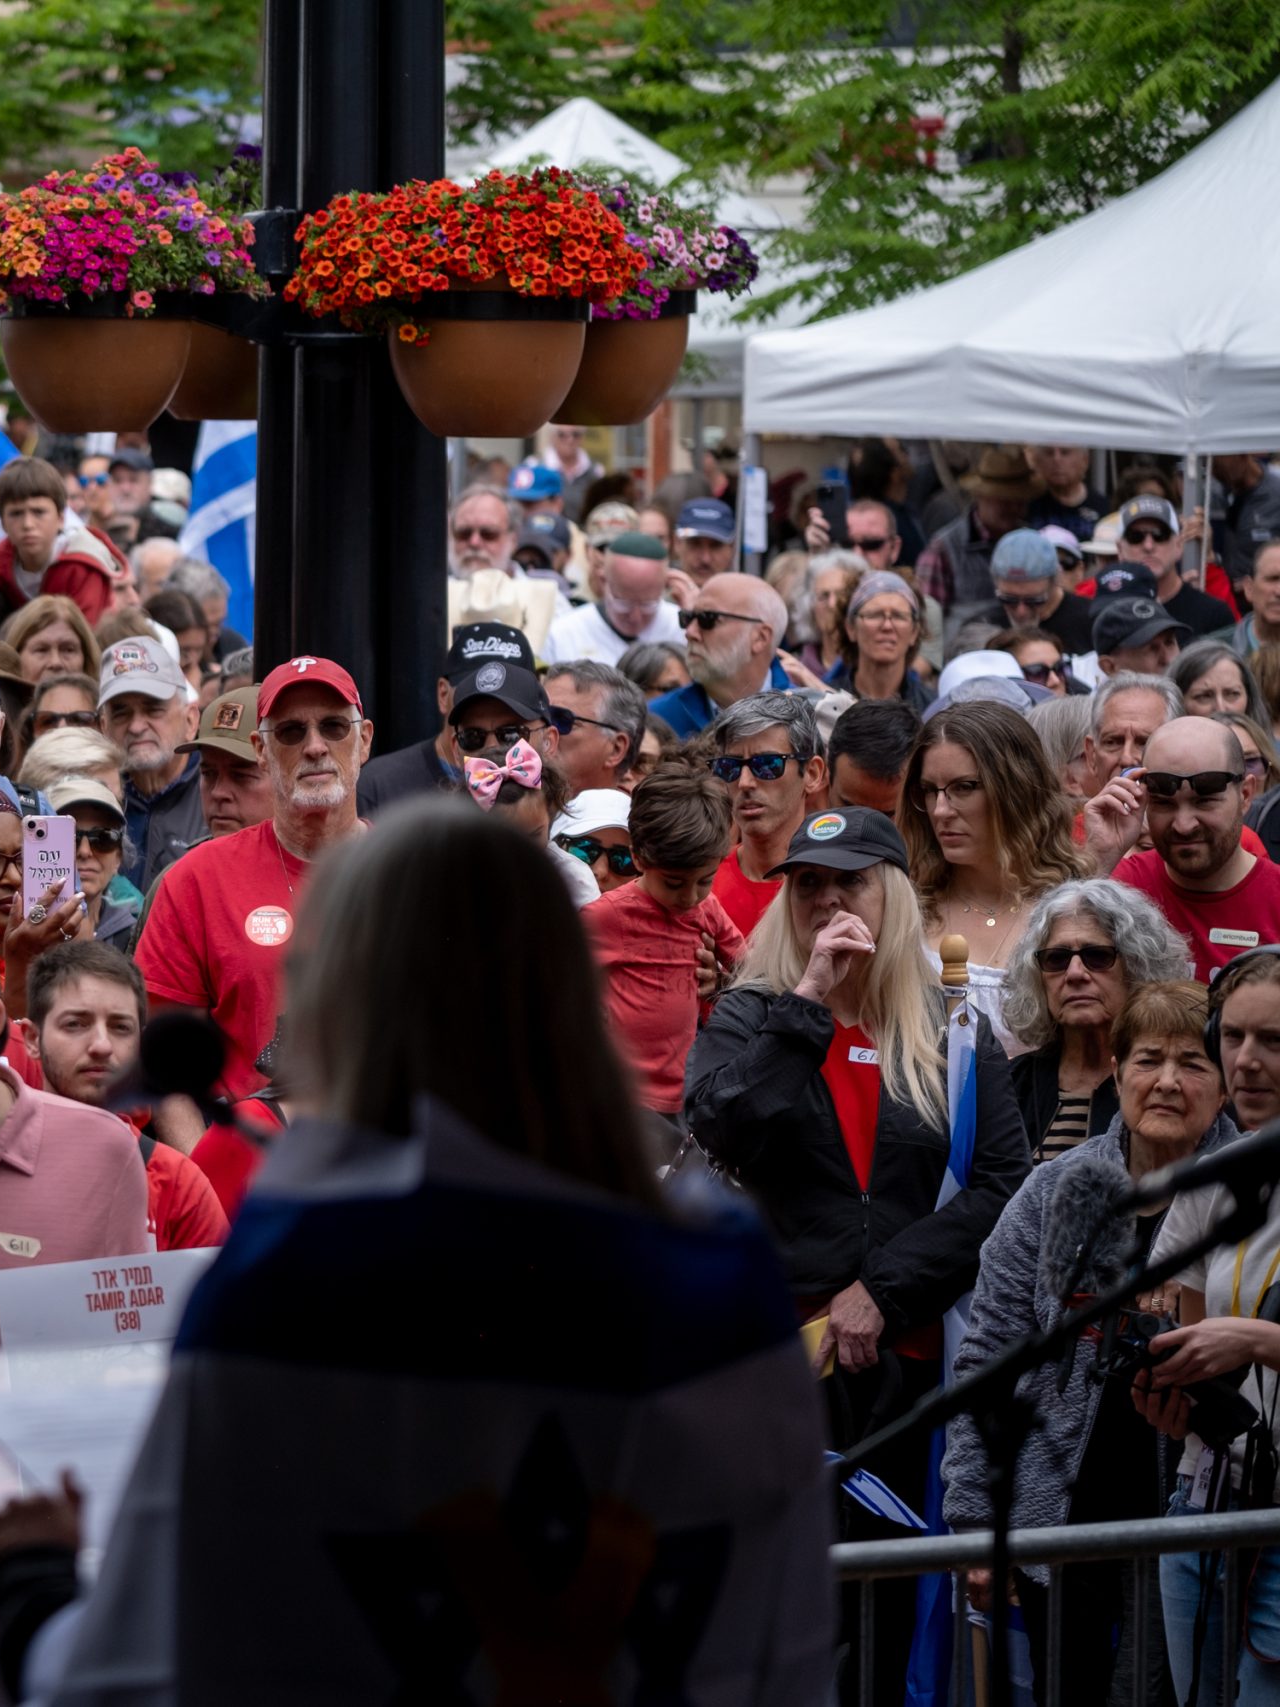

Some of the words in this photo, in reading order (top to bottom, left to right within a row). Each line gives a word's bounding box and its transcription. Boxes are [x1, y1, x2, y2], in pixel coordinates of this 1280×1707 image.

[462, 638, 484, 653] San
[483, 636, 521, 658] Diego
[9, 1238, 31, 1252] 611
[92, 1269, 119, 1290] אדר
[121, 1266, 153, 1287] תמיר
[85, 1290, 127, 1312] TAMIR
[129, 1286, 165, 1308] ADAR
[115, 1309, 141, 1334] (38)
